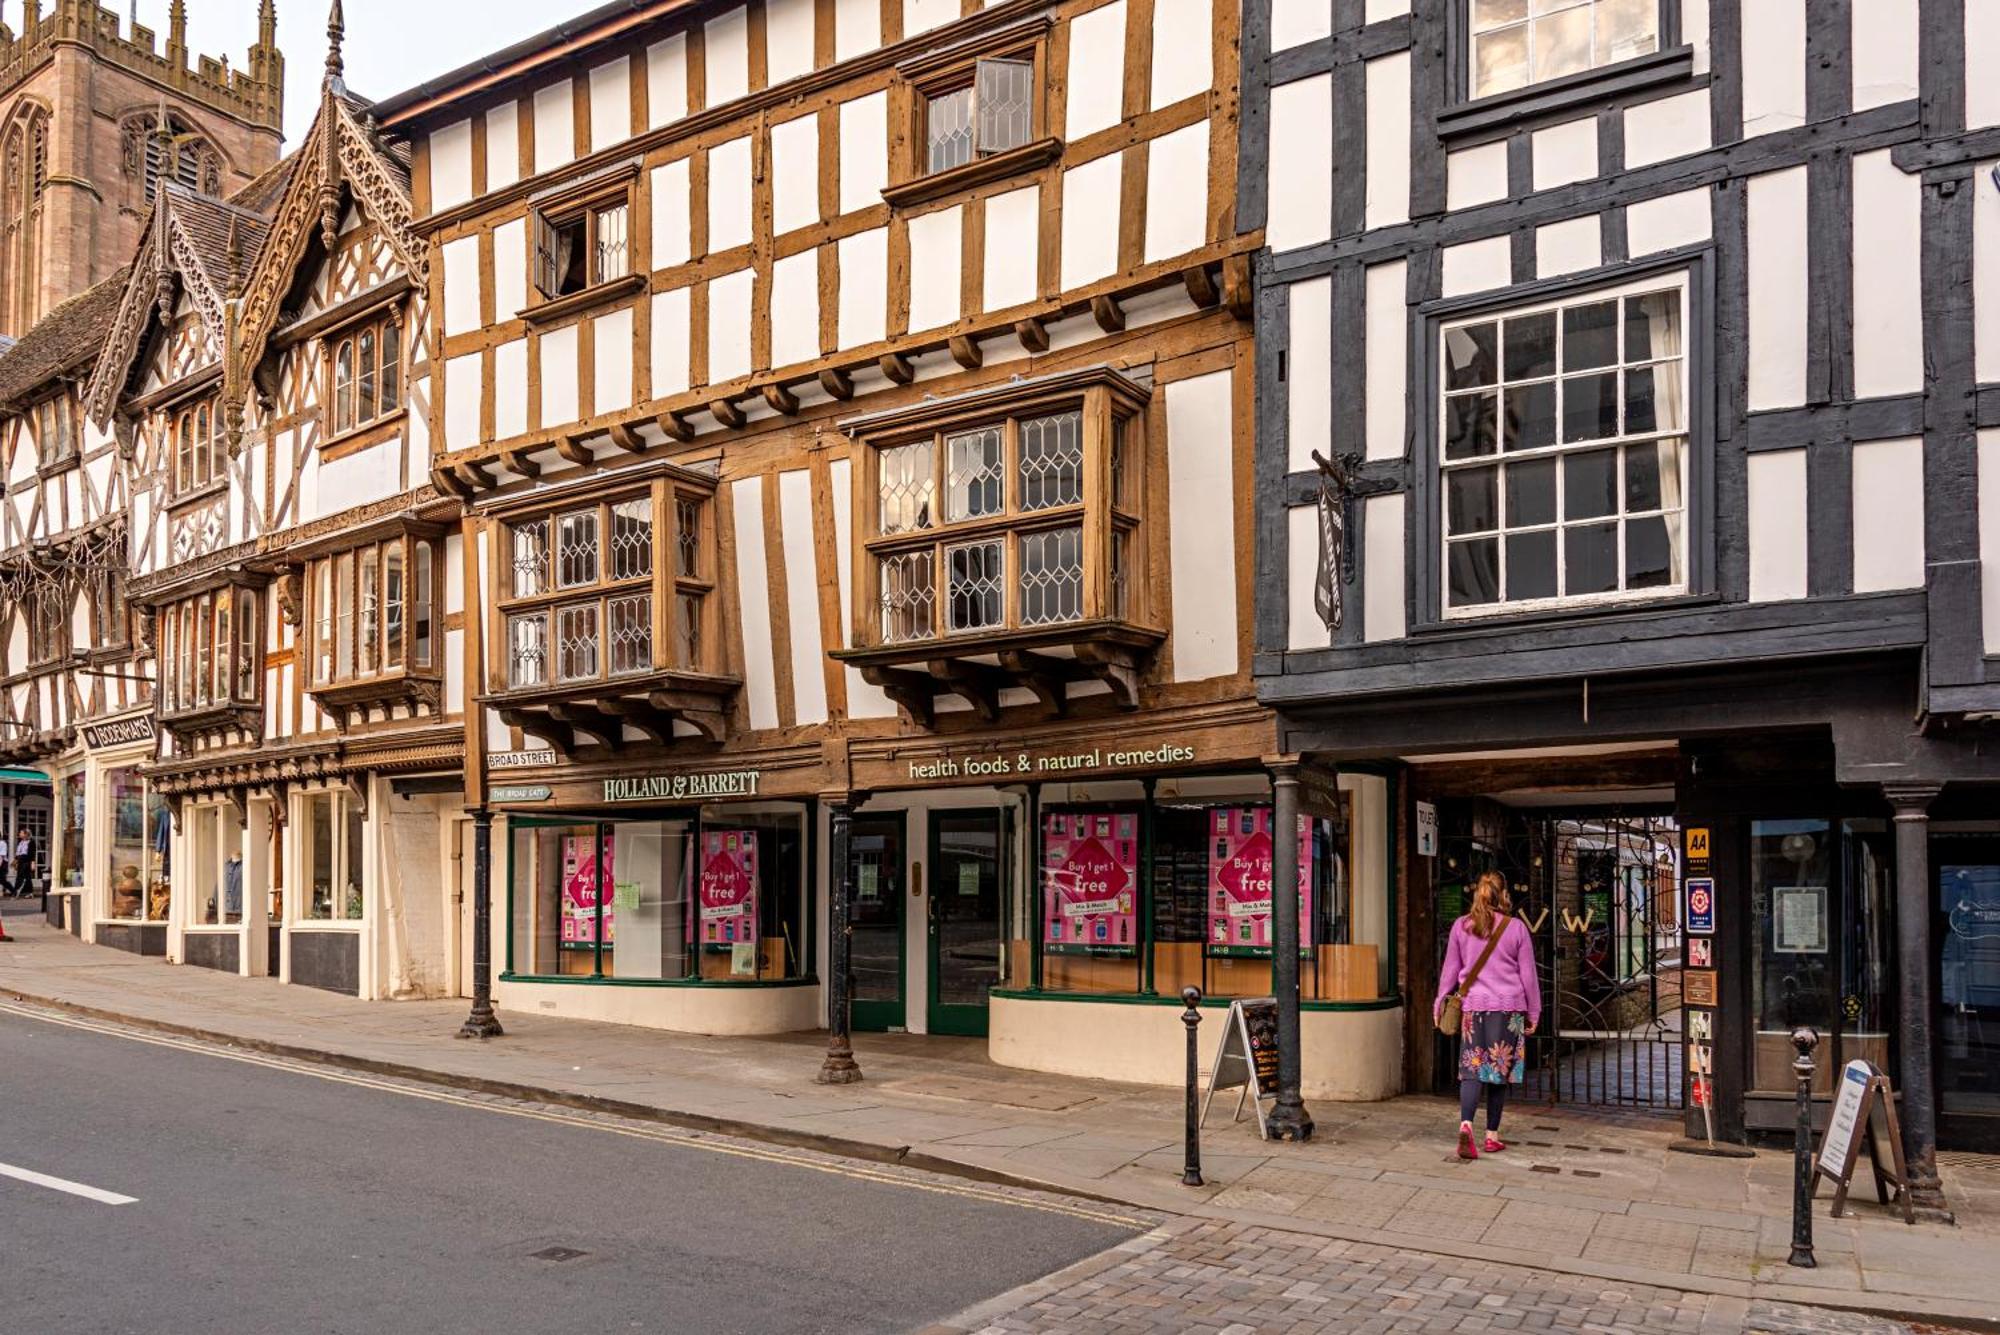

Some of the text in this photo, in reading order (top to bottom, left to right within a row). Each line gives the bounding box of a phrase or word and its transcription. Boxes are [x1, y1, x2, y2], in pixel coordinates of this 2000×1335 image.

[489, 752, 554, 767] BROAD STREET
[909, 744, 1194, 778] health foods & natural remedies
[604, 771, 760, 802] HOLLAND & BARRETT
[1690, 834, 1706, 850] AA
[1068, 861, 1114, 874] Buy 1 get 1
[1233, 858, 1272, 873] Buy 1 ge
[578, 874, 589, 884] Buy
[704, 871, 718, 881] Buy
[1075, 874, 1108, 893] free
[581, 885, 597, 900] fre
[709, 884, 736, 899] free
